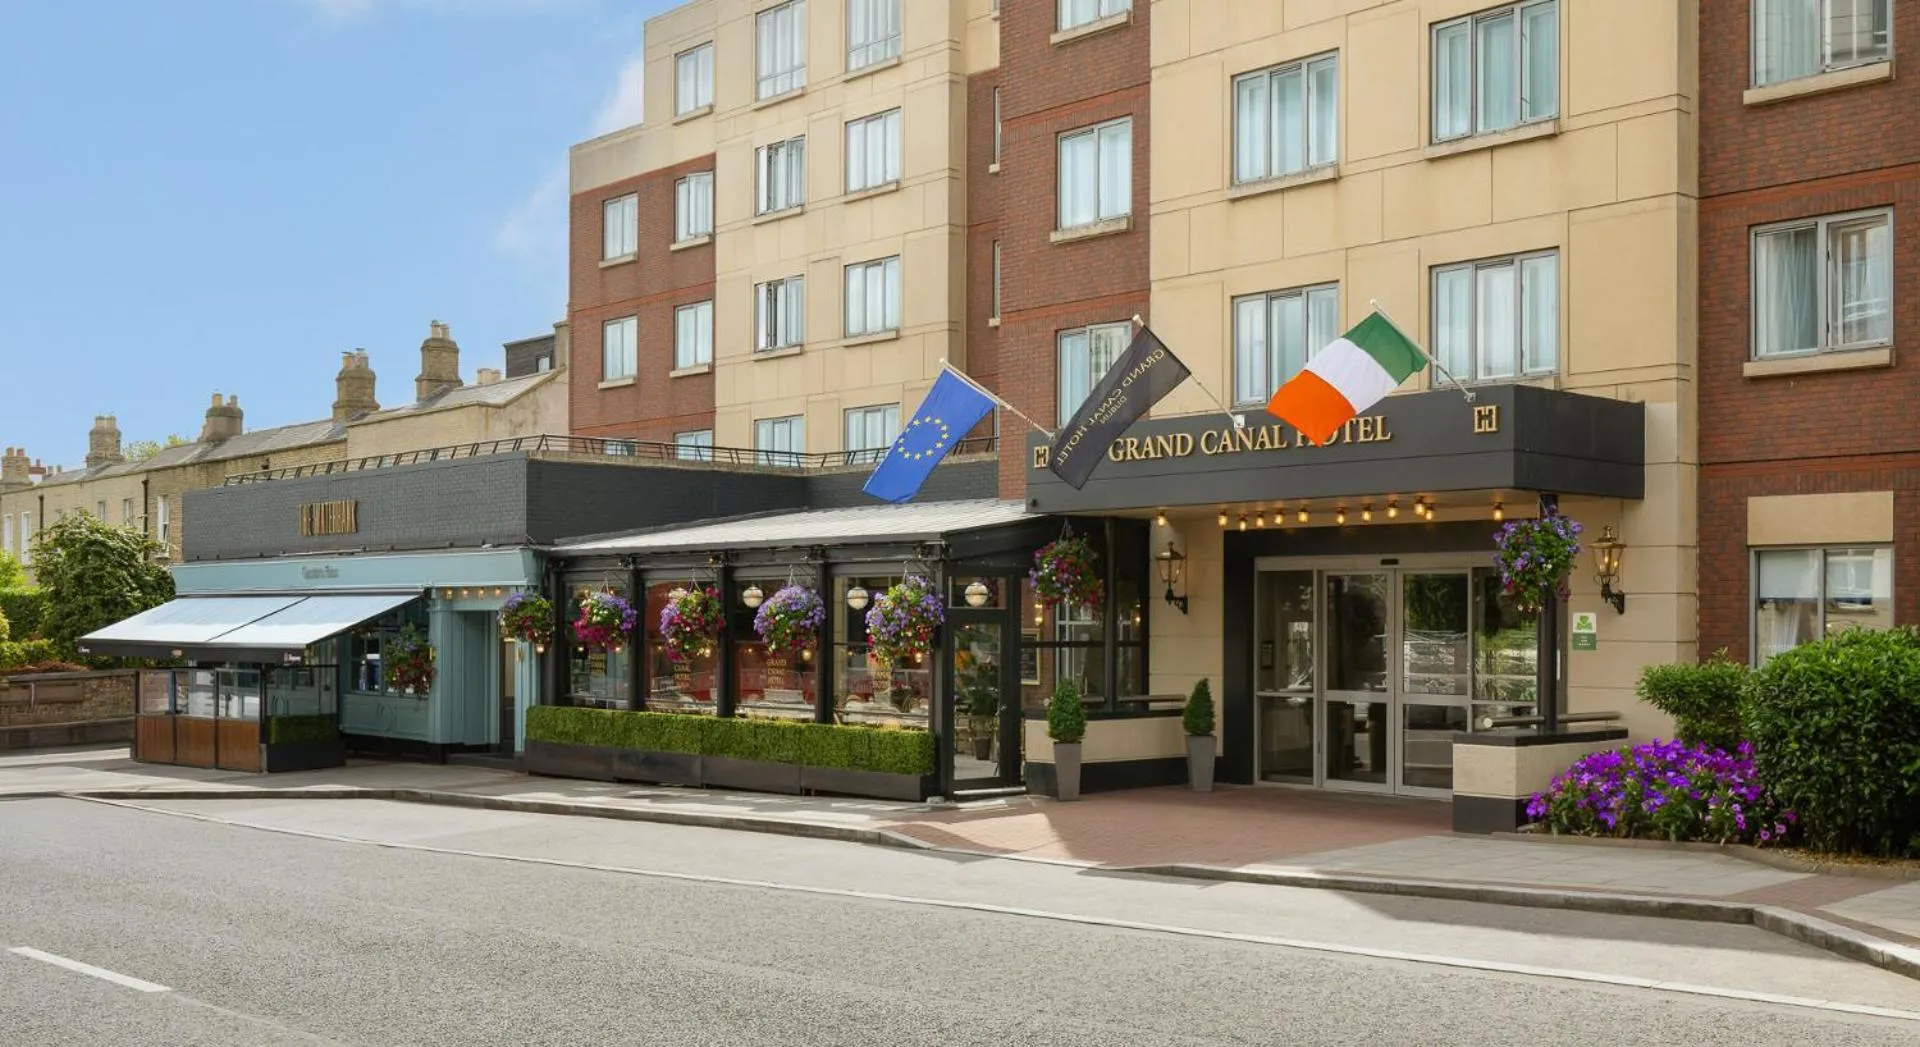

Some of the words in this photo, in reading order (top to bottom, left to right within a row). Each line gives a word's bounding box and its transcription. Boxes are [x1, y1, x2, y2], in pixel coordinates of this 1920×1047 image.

[1109, 433, 1193, 462] GRAND
[1200, 424, 1288, 455] CANAL
[1295, 415, 1391, 447] TEL
